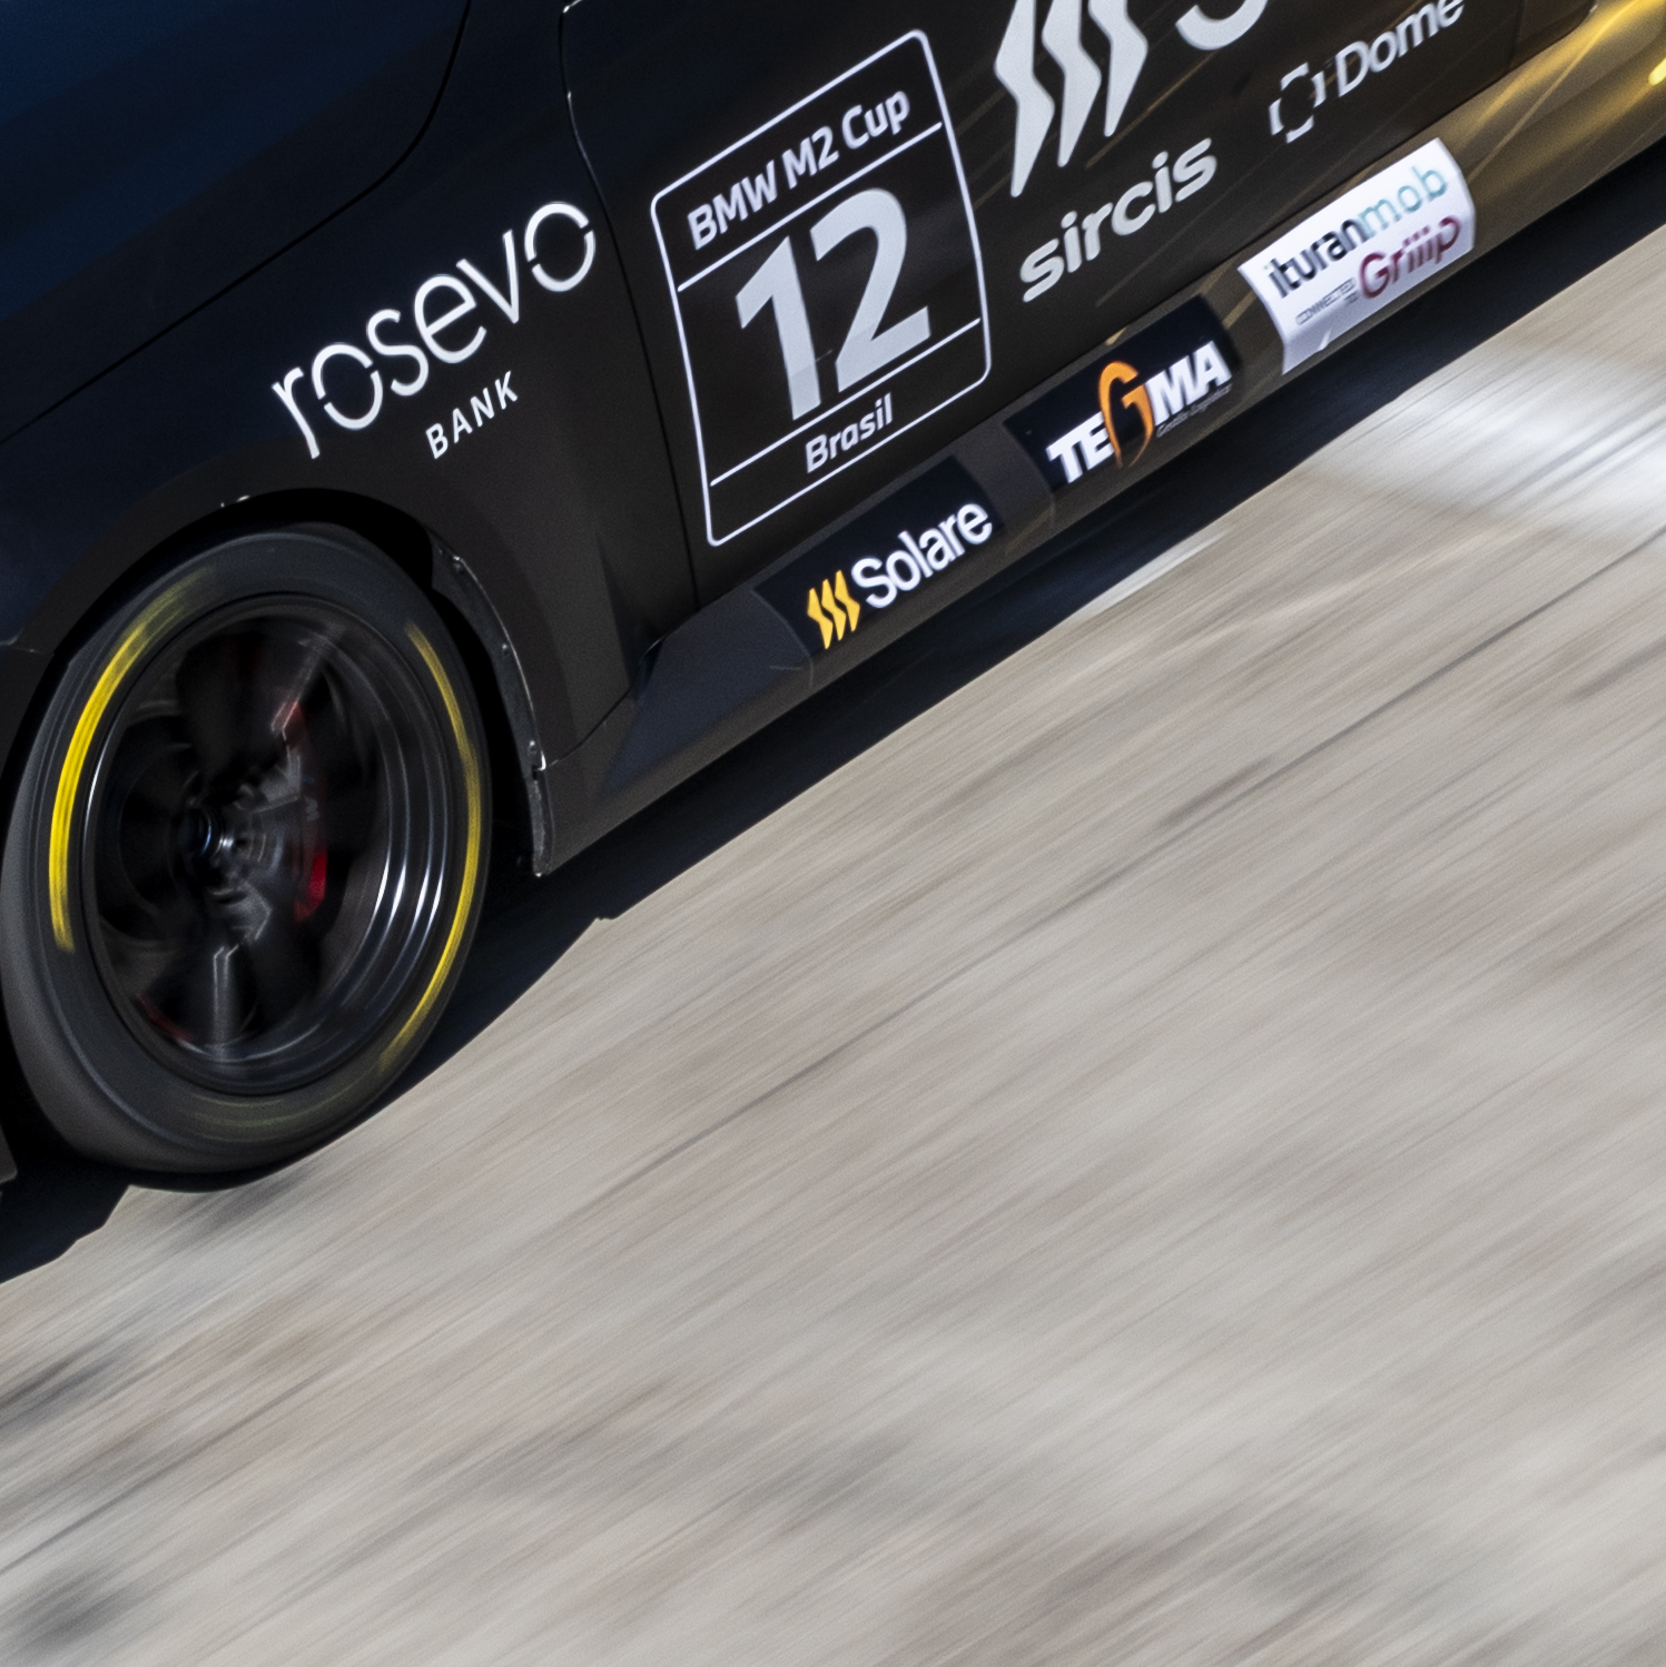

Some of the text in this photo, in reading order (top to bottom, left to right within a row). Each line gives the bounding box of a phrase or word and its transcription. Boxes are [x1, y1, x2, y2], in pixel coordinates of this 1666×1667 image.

[686, 90, 911, 251] BMW M2 Cup
[1019, 138, 1218, 304] sircis
[270, 200, 597, 460] rosevo
[734, 187, 931, 422] 12
[424, 370, 520, 461] BANK
[804, 392, 894, 474] Brasil
[1046, 339, 1233, 485] TEGMA
[850, 501, 994, 610] Solare
